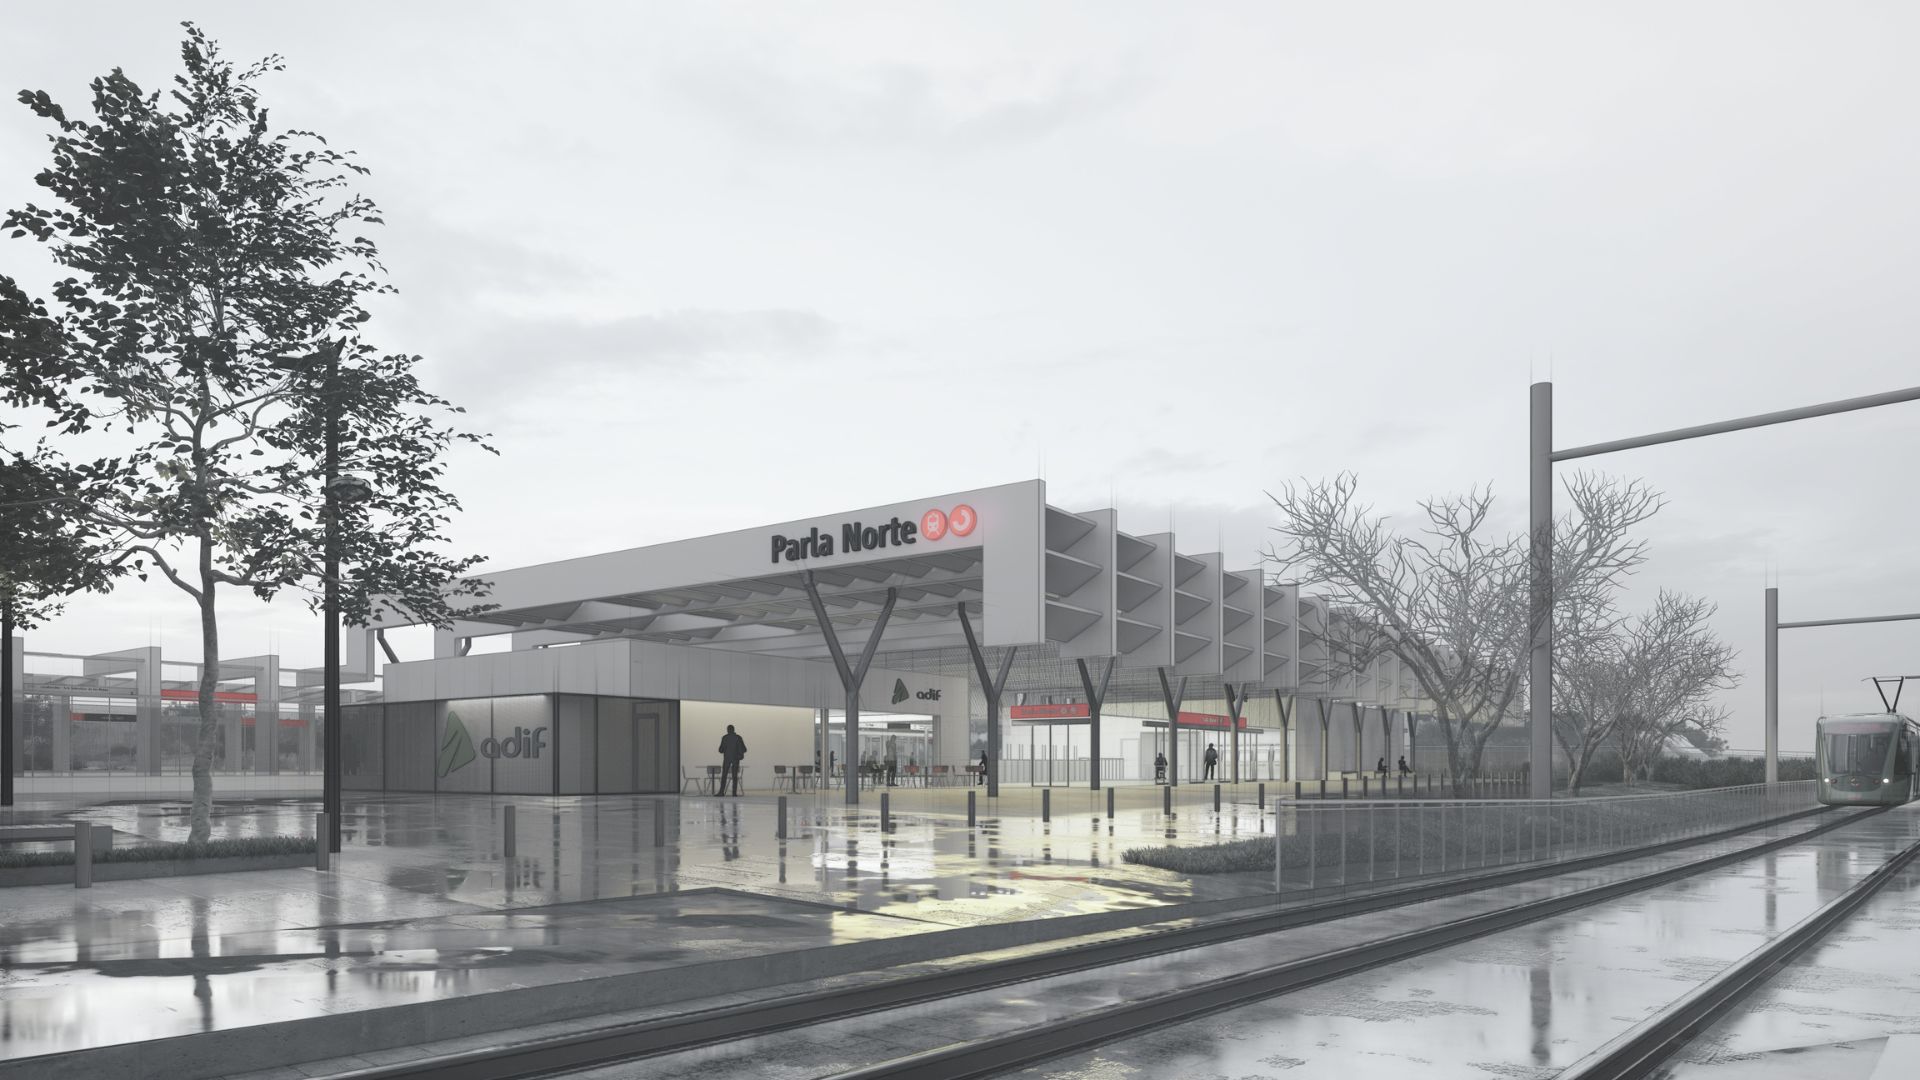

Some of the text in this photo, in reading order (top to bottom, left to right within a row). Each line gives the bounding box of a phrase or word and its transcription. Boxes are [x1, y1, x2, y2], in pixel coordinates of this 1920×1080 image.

[771, 517, 917, 563] Parla Norte
[916, 688, 942, 701] adif
[480, 726, 547, 759] adif
